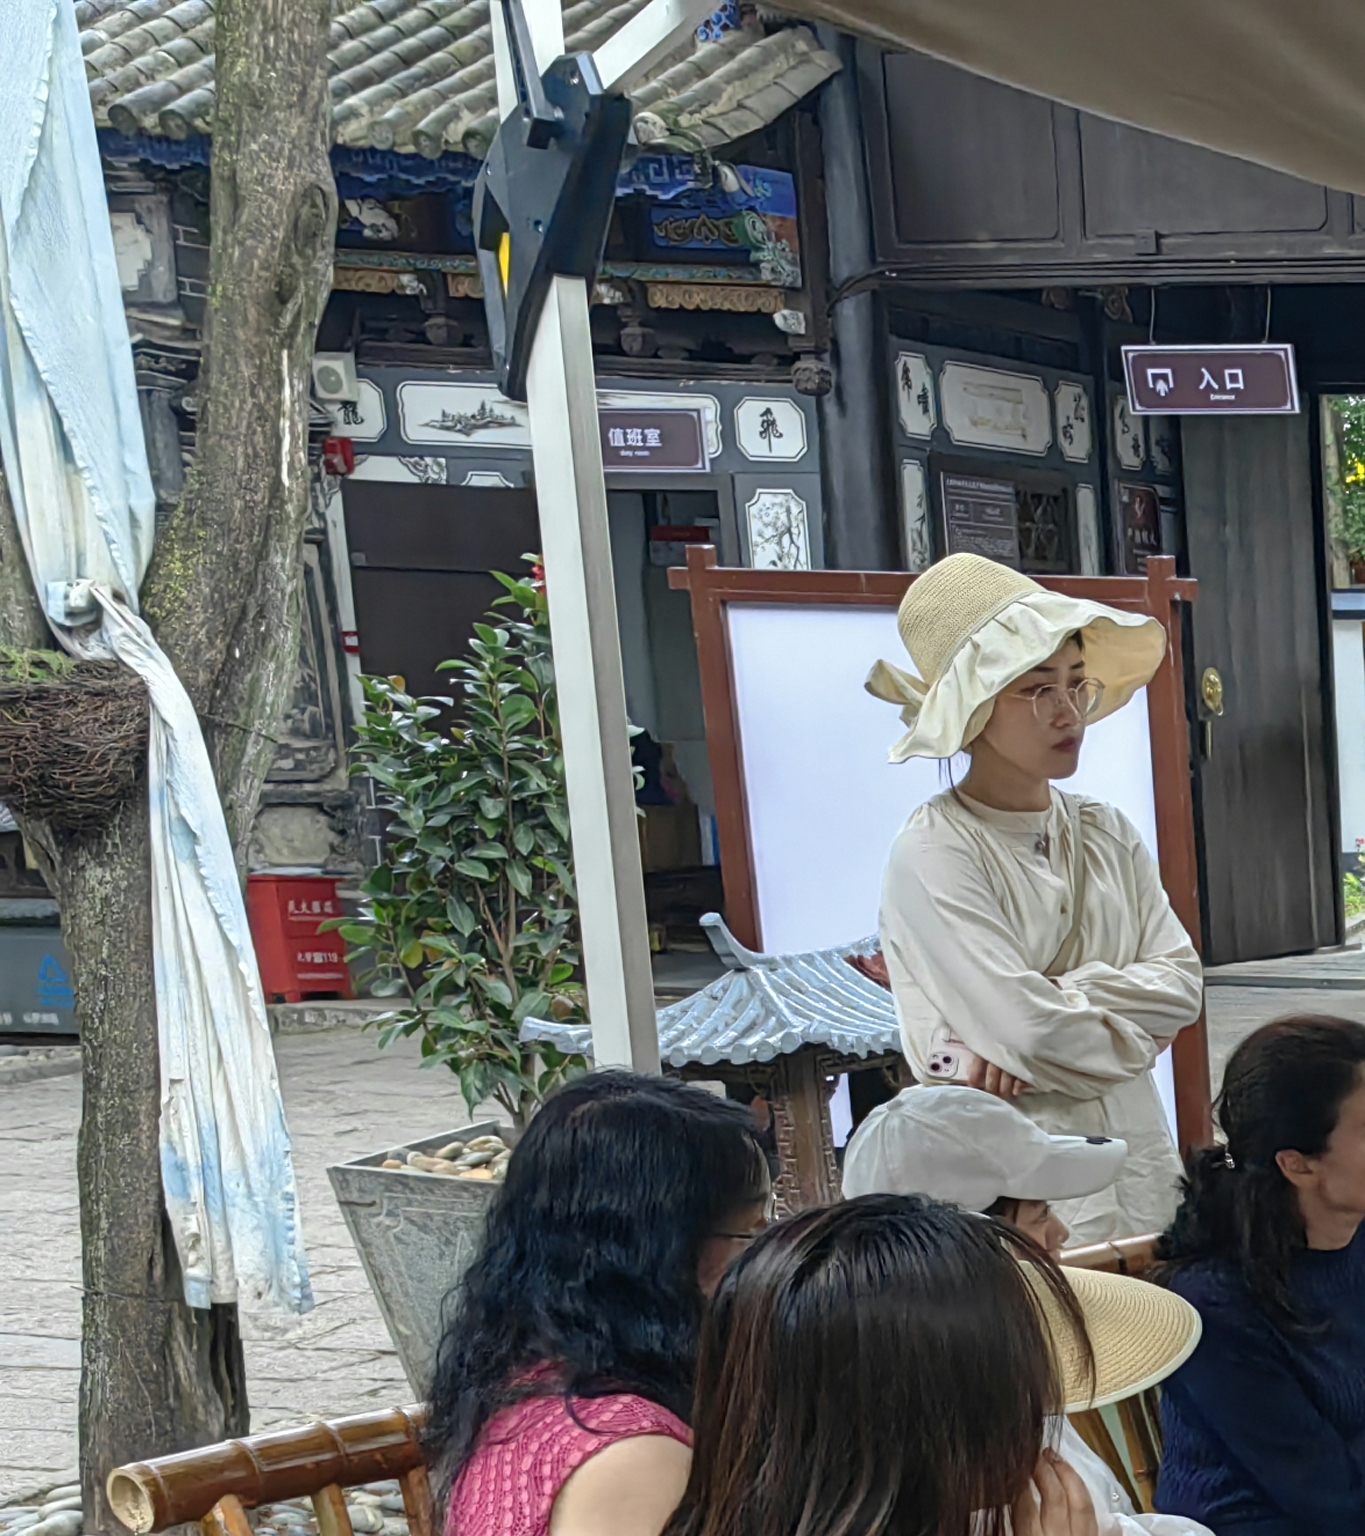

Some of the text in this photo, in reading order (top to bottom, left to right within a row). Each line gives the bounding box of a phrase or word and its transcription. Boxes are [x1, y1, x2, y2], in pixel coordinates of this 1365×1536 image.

[1199, 367, 1244, 390] 入口
[607, 427, 663, 447] 值班室
